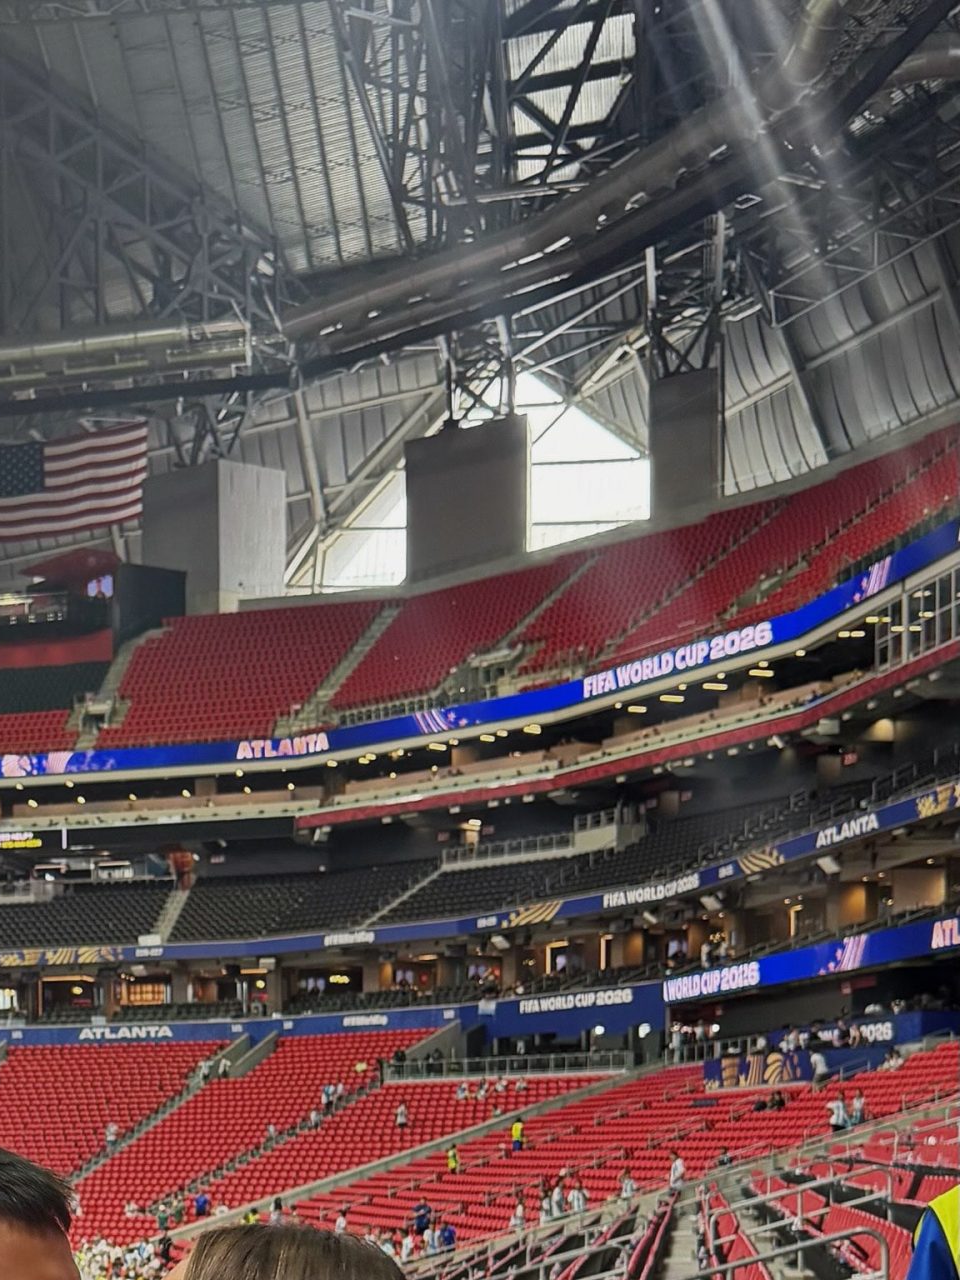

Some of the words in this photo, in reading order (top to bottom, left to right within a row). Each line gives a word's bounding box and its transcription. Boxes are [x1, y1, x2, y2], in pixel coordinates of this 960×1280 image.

[583, 669, 617, 699] FIFA
[616, 654, 674, 687] WORLD
[674, 640, 710, 670] CUP
[709, 621, 773, 660] 2026
[236, 732, 330, 760] ATLANTA
[815, 813, 879, 849] ATLANTA
[603, 894, 626, 908] FIFA
[626, 886, 665, 904] WORLD
[664, 880, 680, 898] CUP
[678, 873, 700, 893] 2026
[520, 999, 540, 1014] FIFA
[541, 994, 575, 1011] WORLD
[574, 992, 595, 1008] CUP
[596, 988, 633, 1006] 2026
[667, 974, 701, 1001] WORLD
[701, 969, 721, 994] CUP
[79, 1026, 173, 1040] ATLANTA
